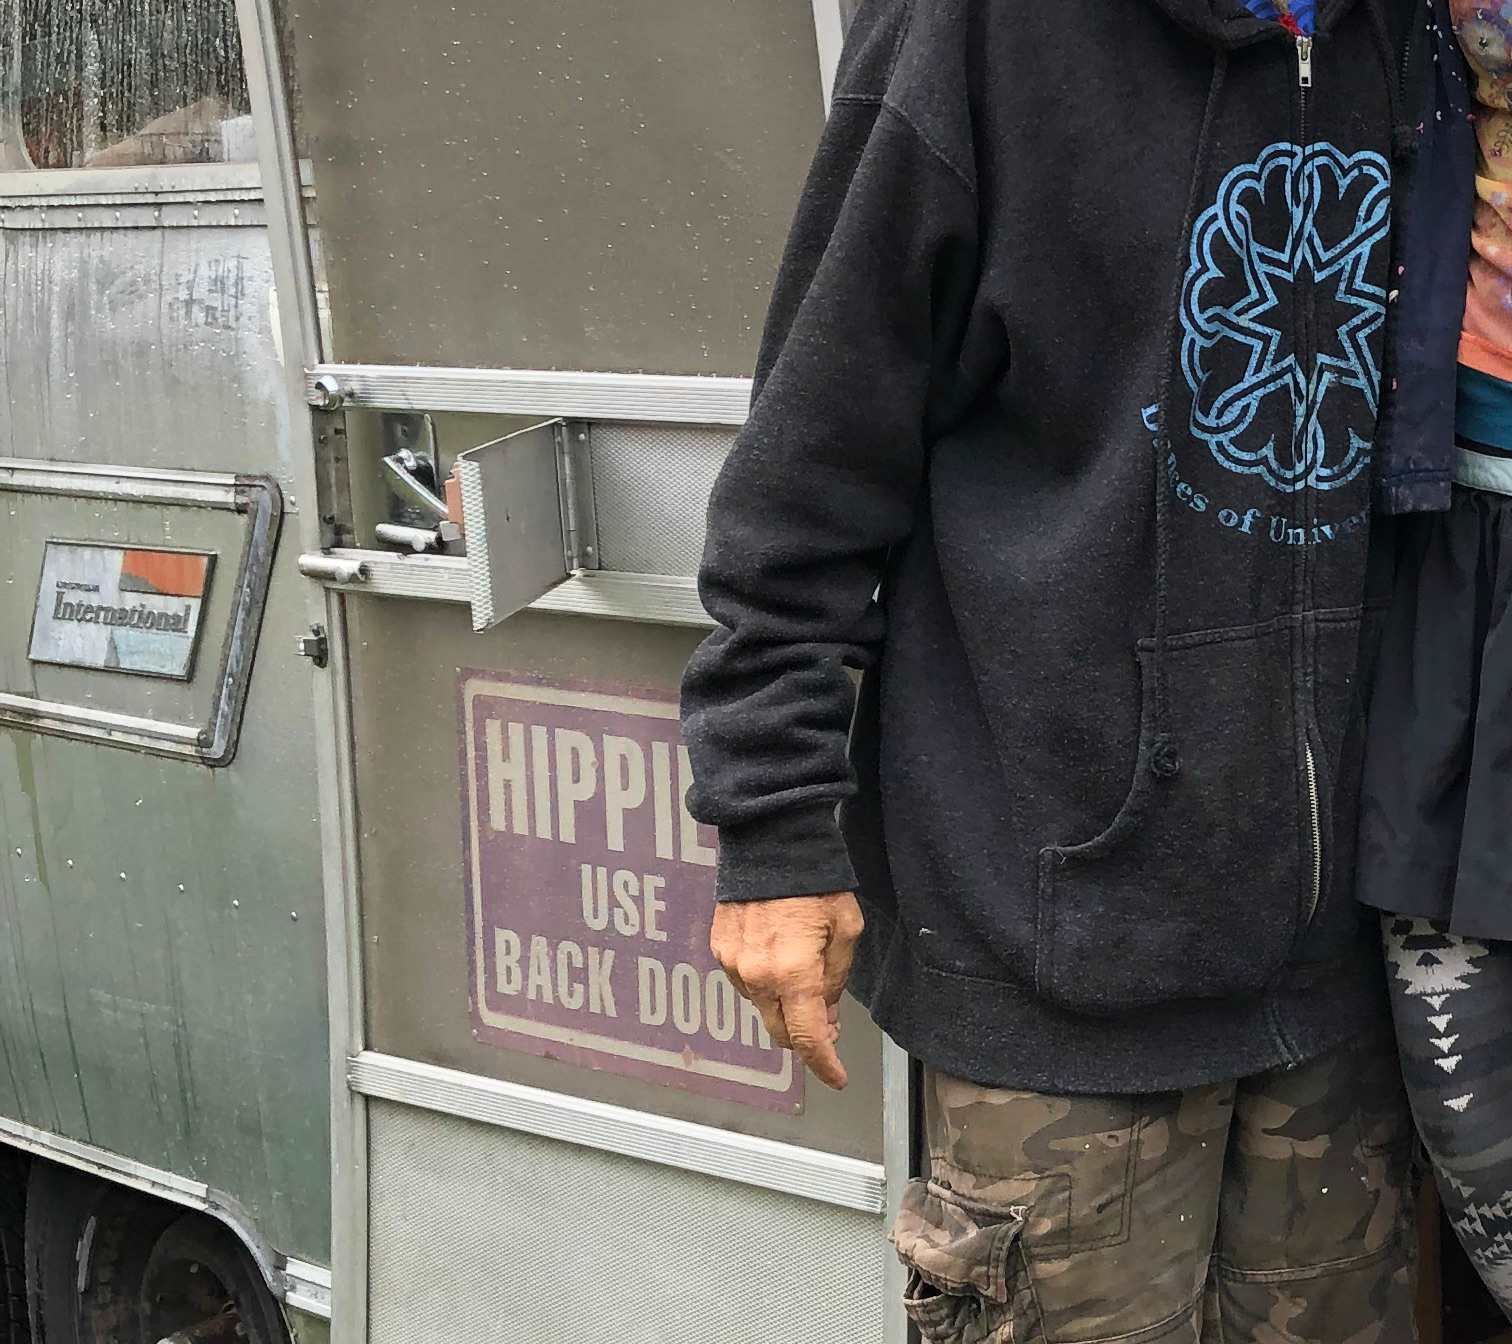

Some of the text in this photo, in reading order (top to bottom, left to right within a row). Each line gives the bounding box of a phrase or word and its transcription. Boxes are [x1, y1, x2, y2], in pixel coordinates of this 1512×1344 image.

[1217, 507, 1263, 535] of
[53, 590, 191, 634] International
[581, 863, 668, 943] USE
[495, 927, 617, 1018] BACK
